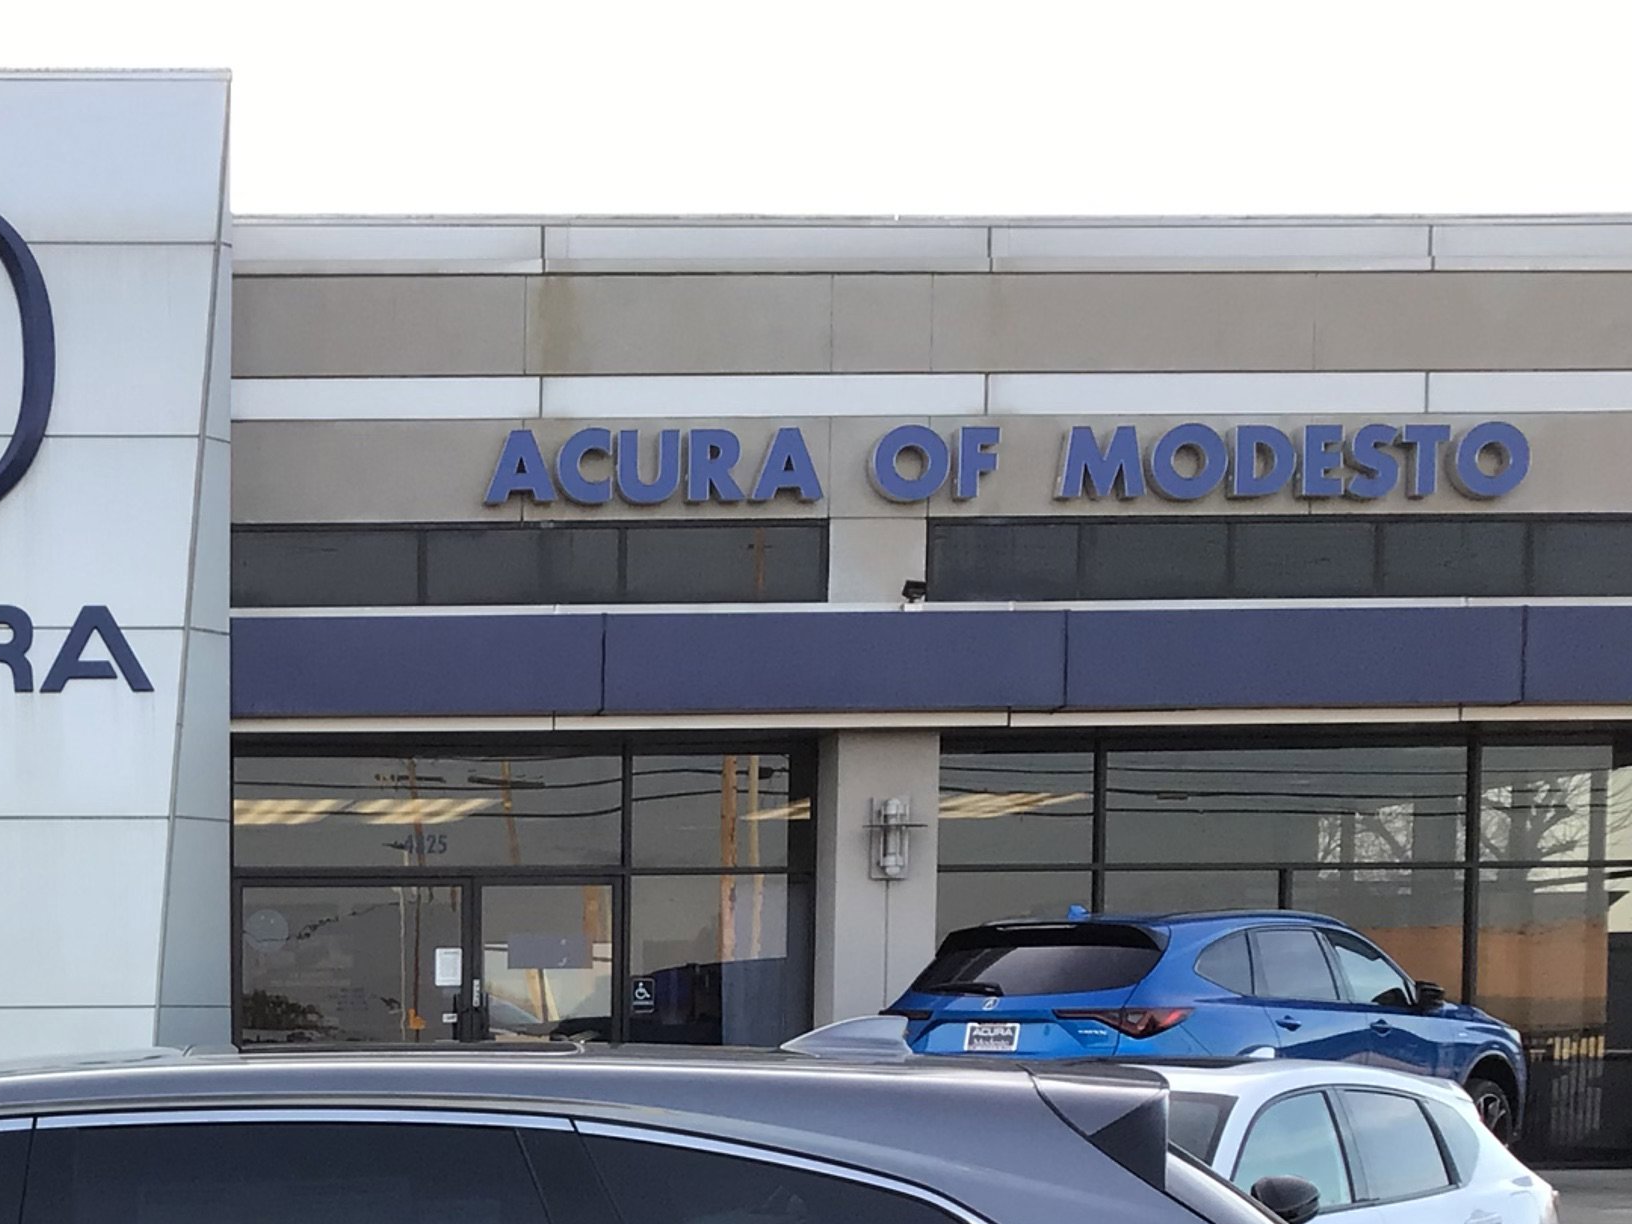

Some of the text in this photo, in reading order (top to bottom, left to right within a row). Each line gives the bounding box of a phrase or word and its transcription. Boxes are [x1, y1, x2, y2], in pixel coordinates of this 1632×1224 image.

[484, 420, 1532, 506] ACURA OF MODESTO
[972, 1026, 1014, 1036] ACURA
